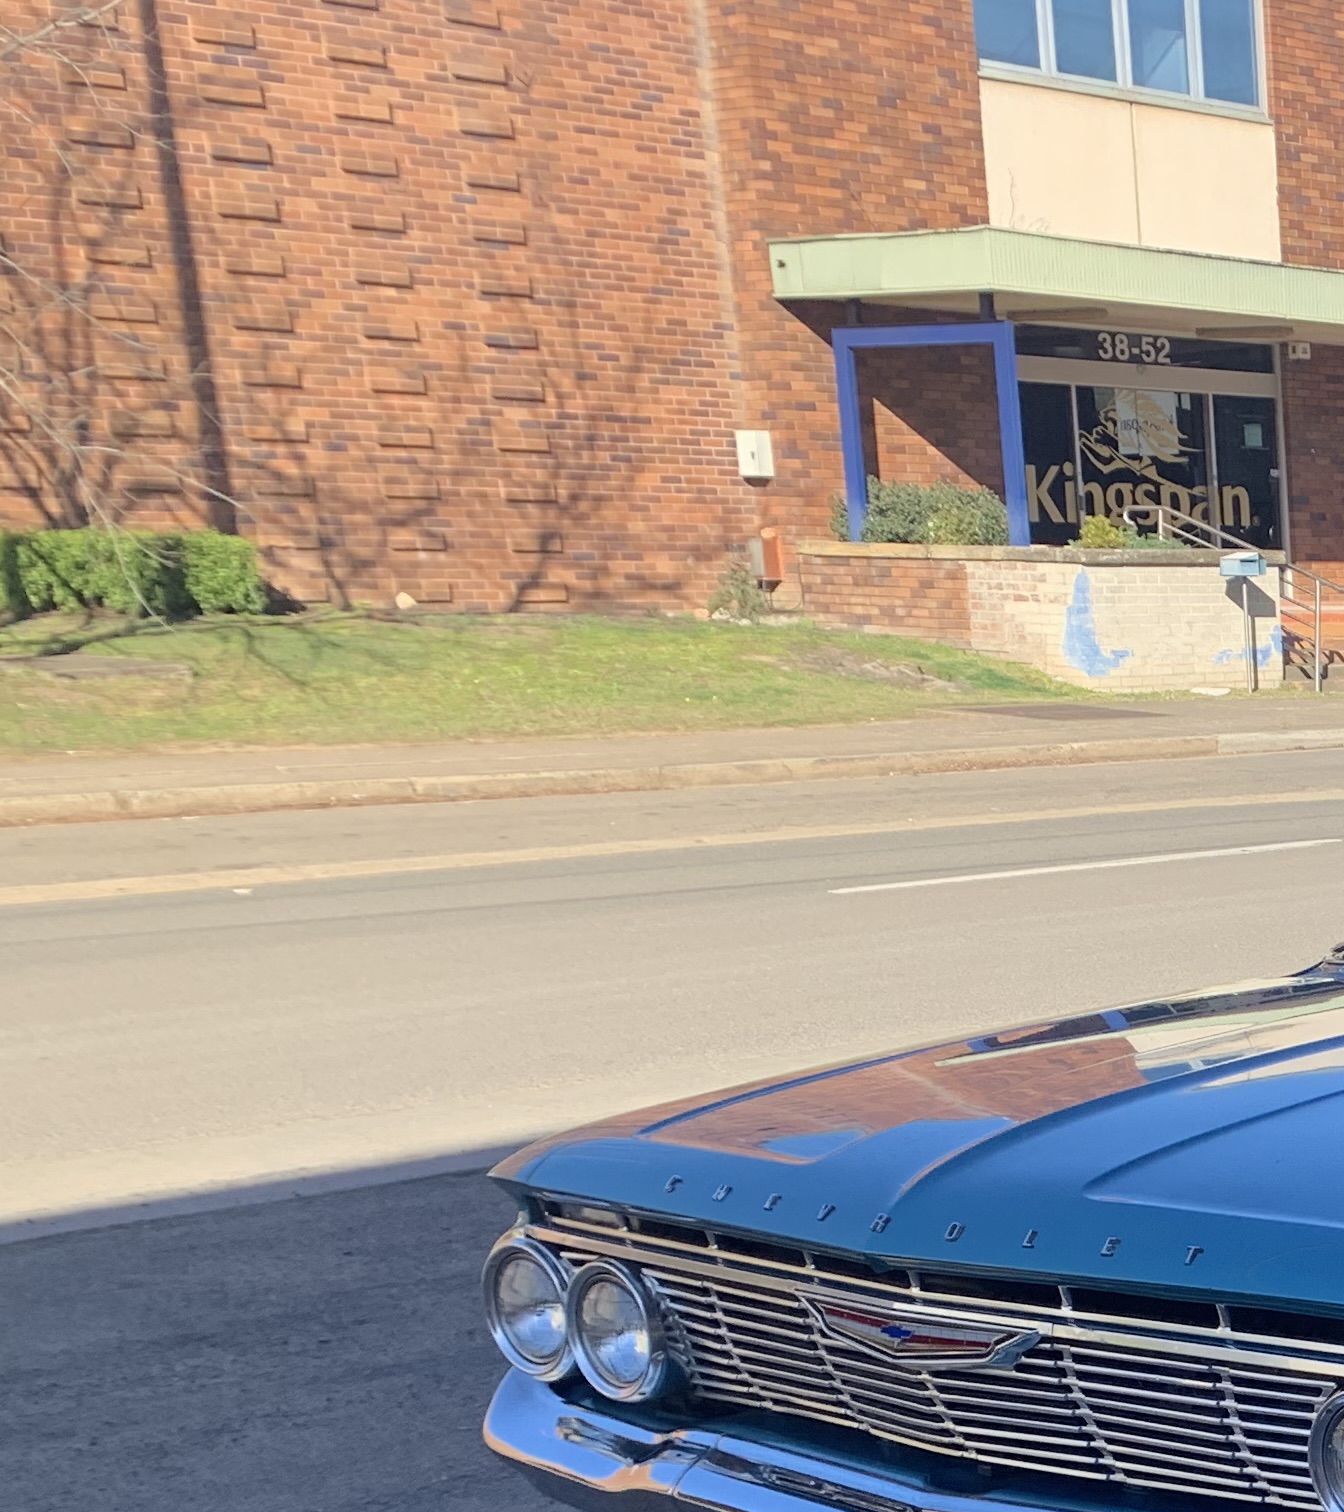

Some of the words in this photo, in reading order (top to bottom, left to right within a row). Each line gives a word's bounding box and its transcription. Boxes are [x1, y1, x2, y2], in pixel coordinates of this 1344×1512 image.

[1097, 332, 1171, 364] 38-52
[1025, 461, 1250, 537] Kingspan
[664, 1174, 1204, 1266] CHEVROLET
